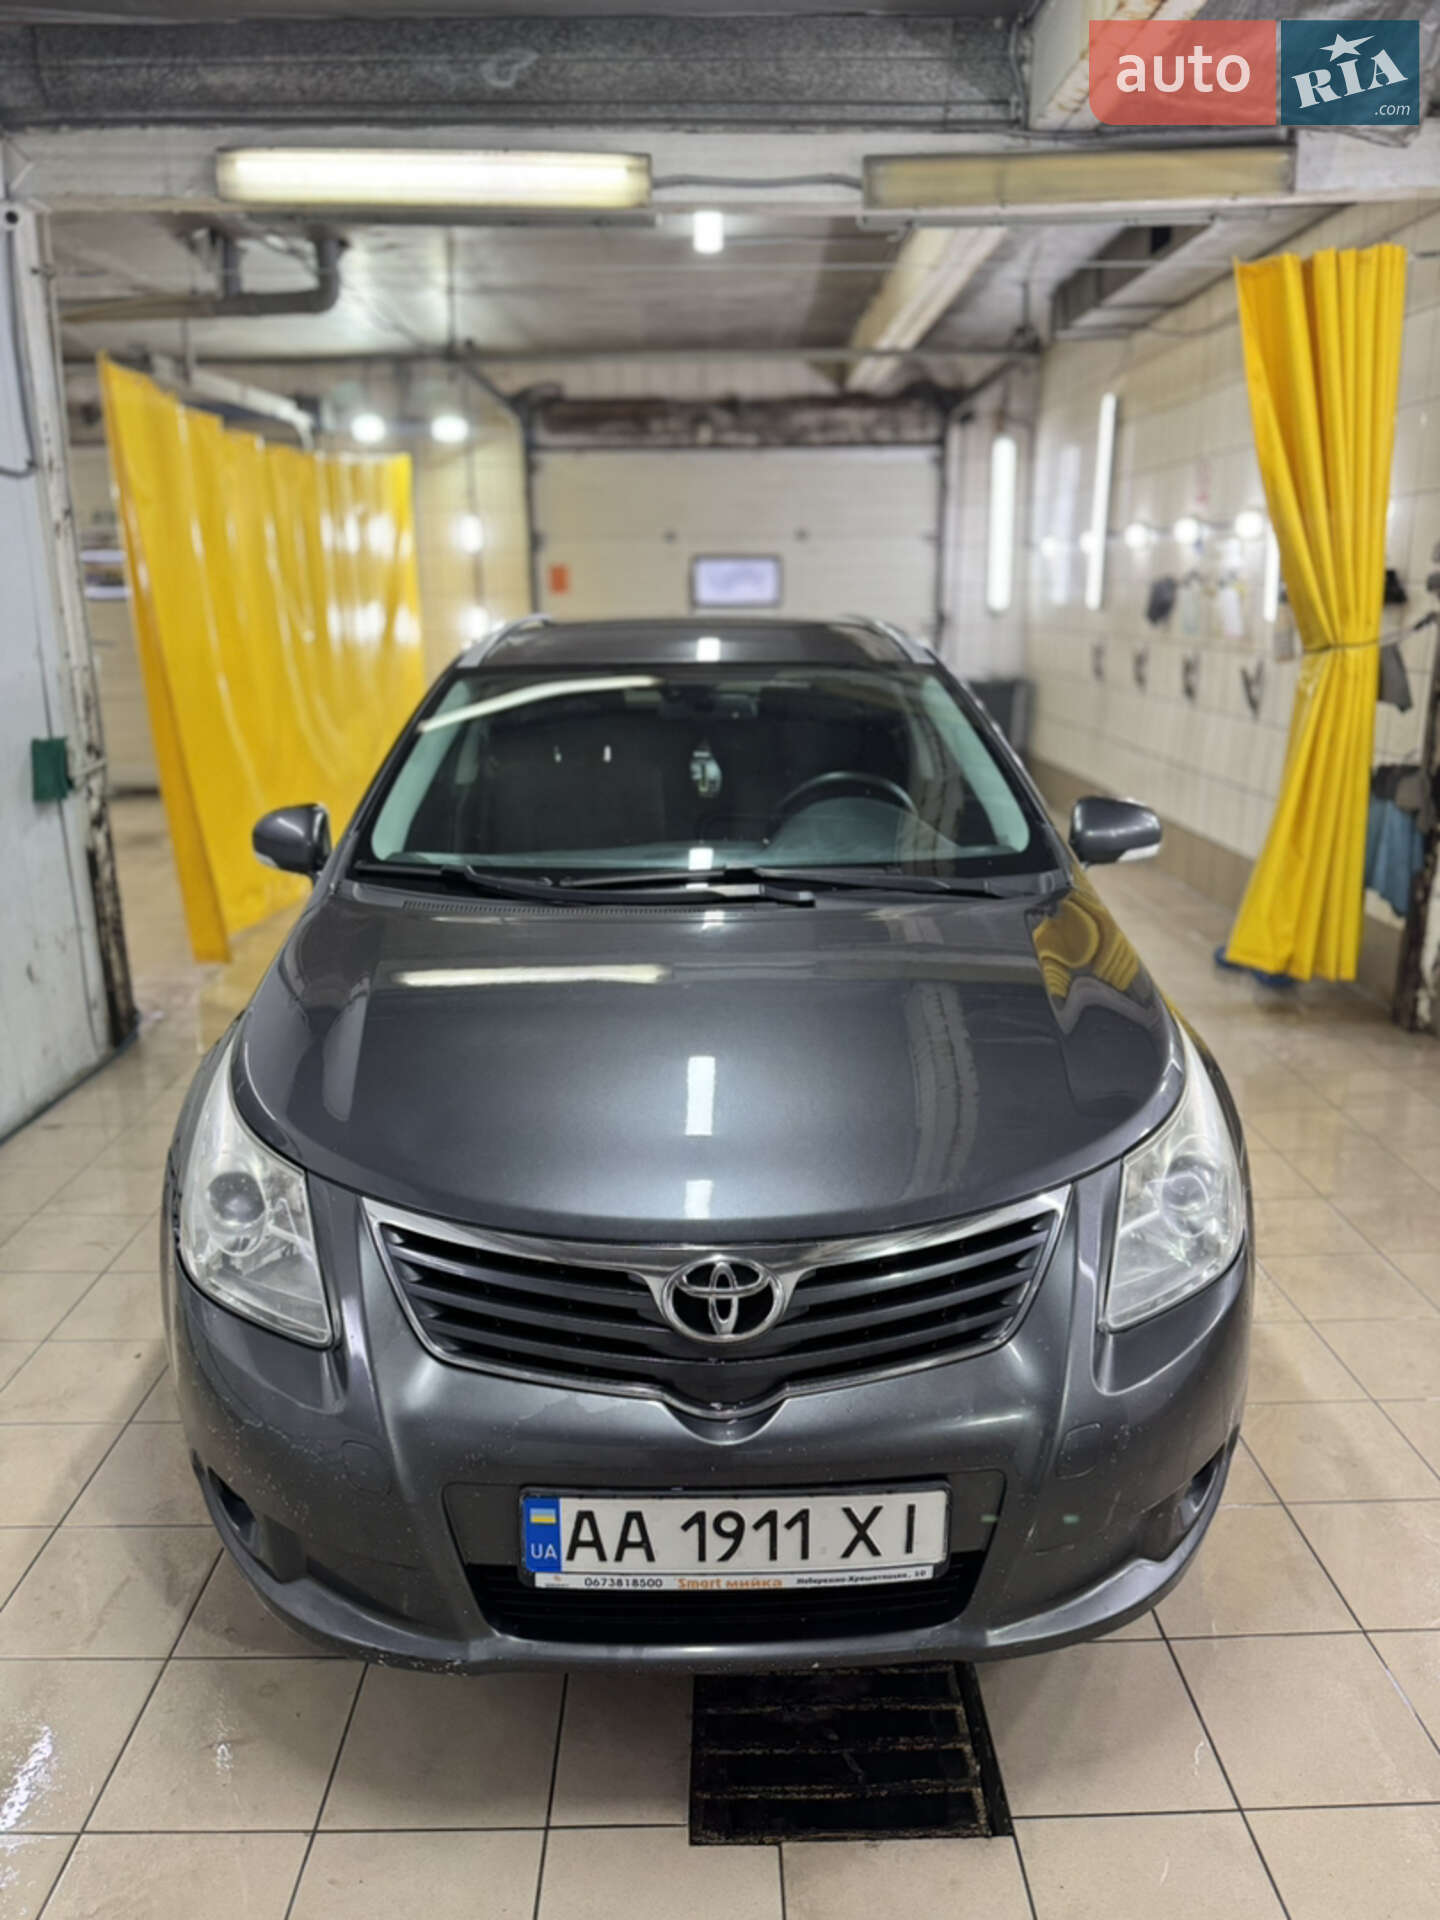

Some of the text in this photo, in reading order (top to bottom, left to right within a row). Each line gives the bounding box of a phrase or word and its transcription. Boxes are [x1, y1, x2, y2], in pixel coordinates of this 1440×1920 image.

[566, 1503, 916, 1563] AA 1911 XI
[530, 1543, 558, 1560] UA
[584, 1577, 663, 1588] 0673818500
[677, 1577, 783, 1590] Smart мийка
